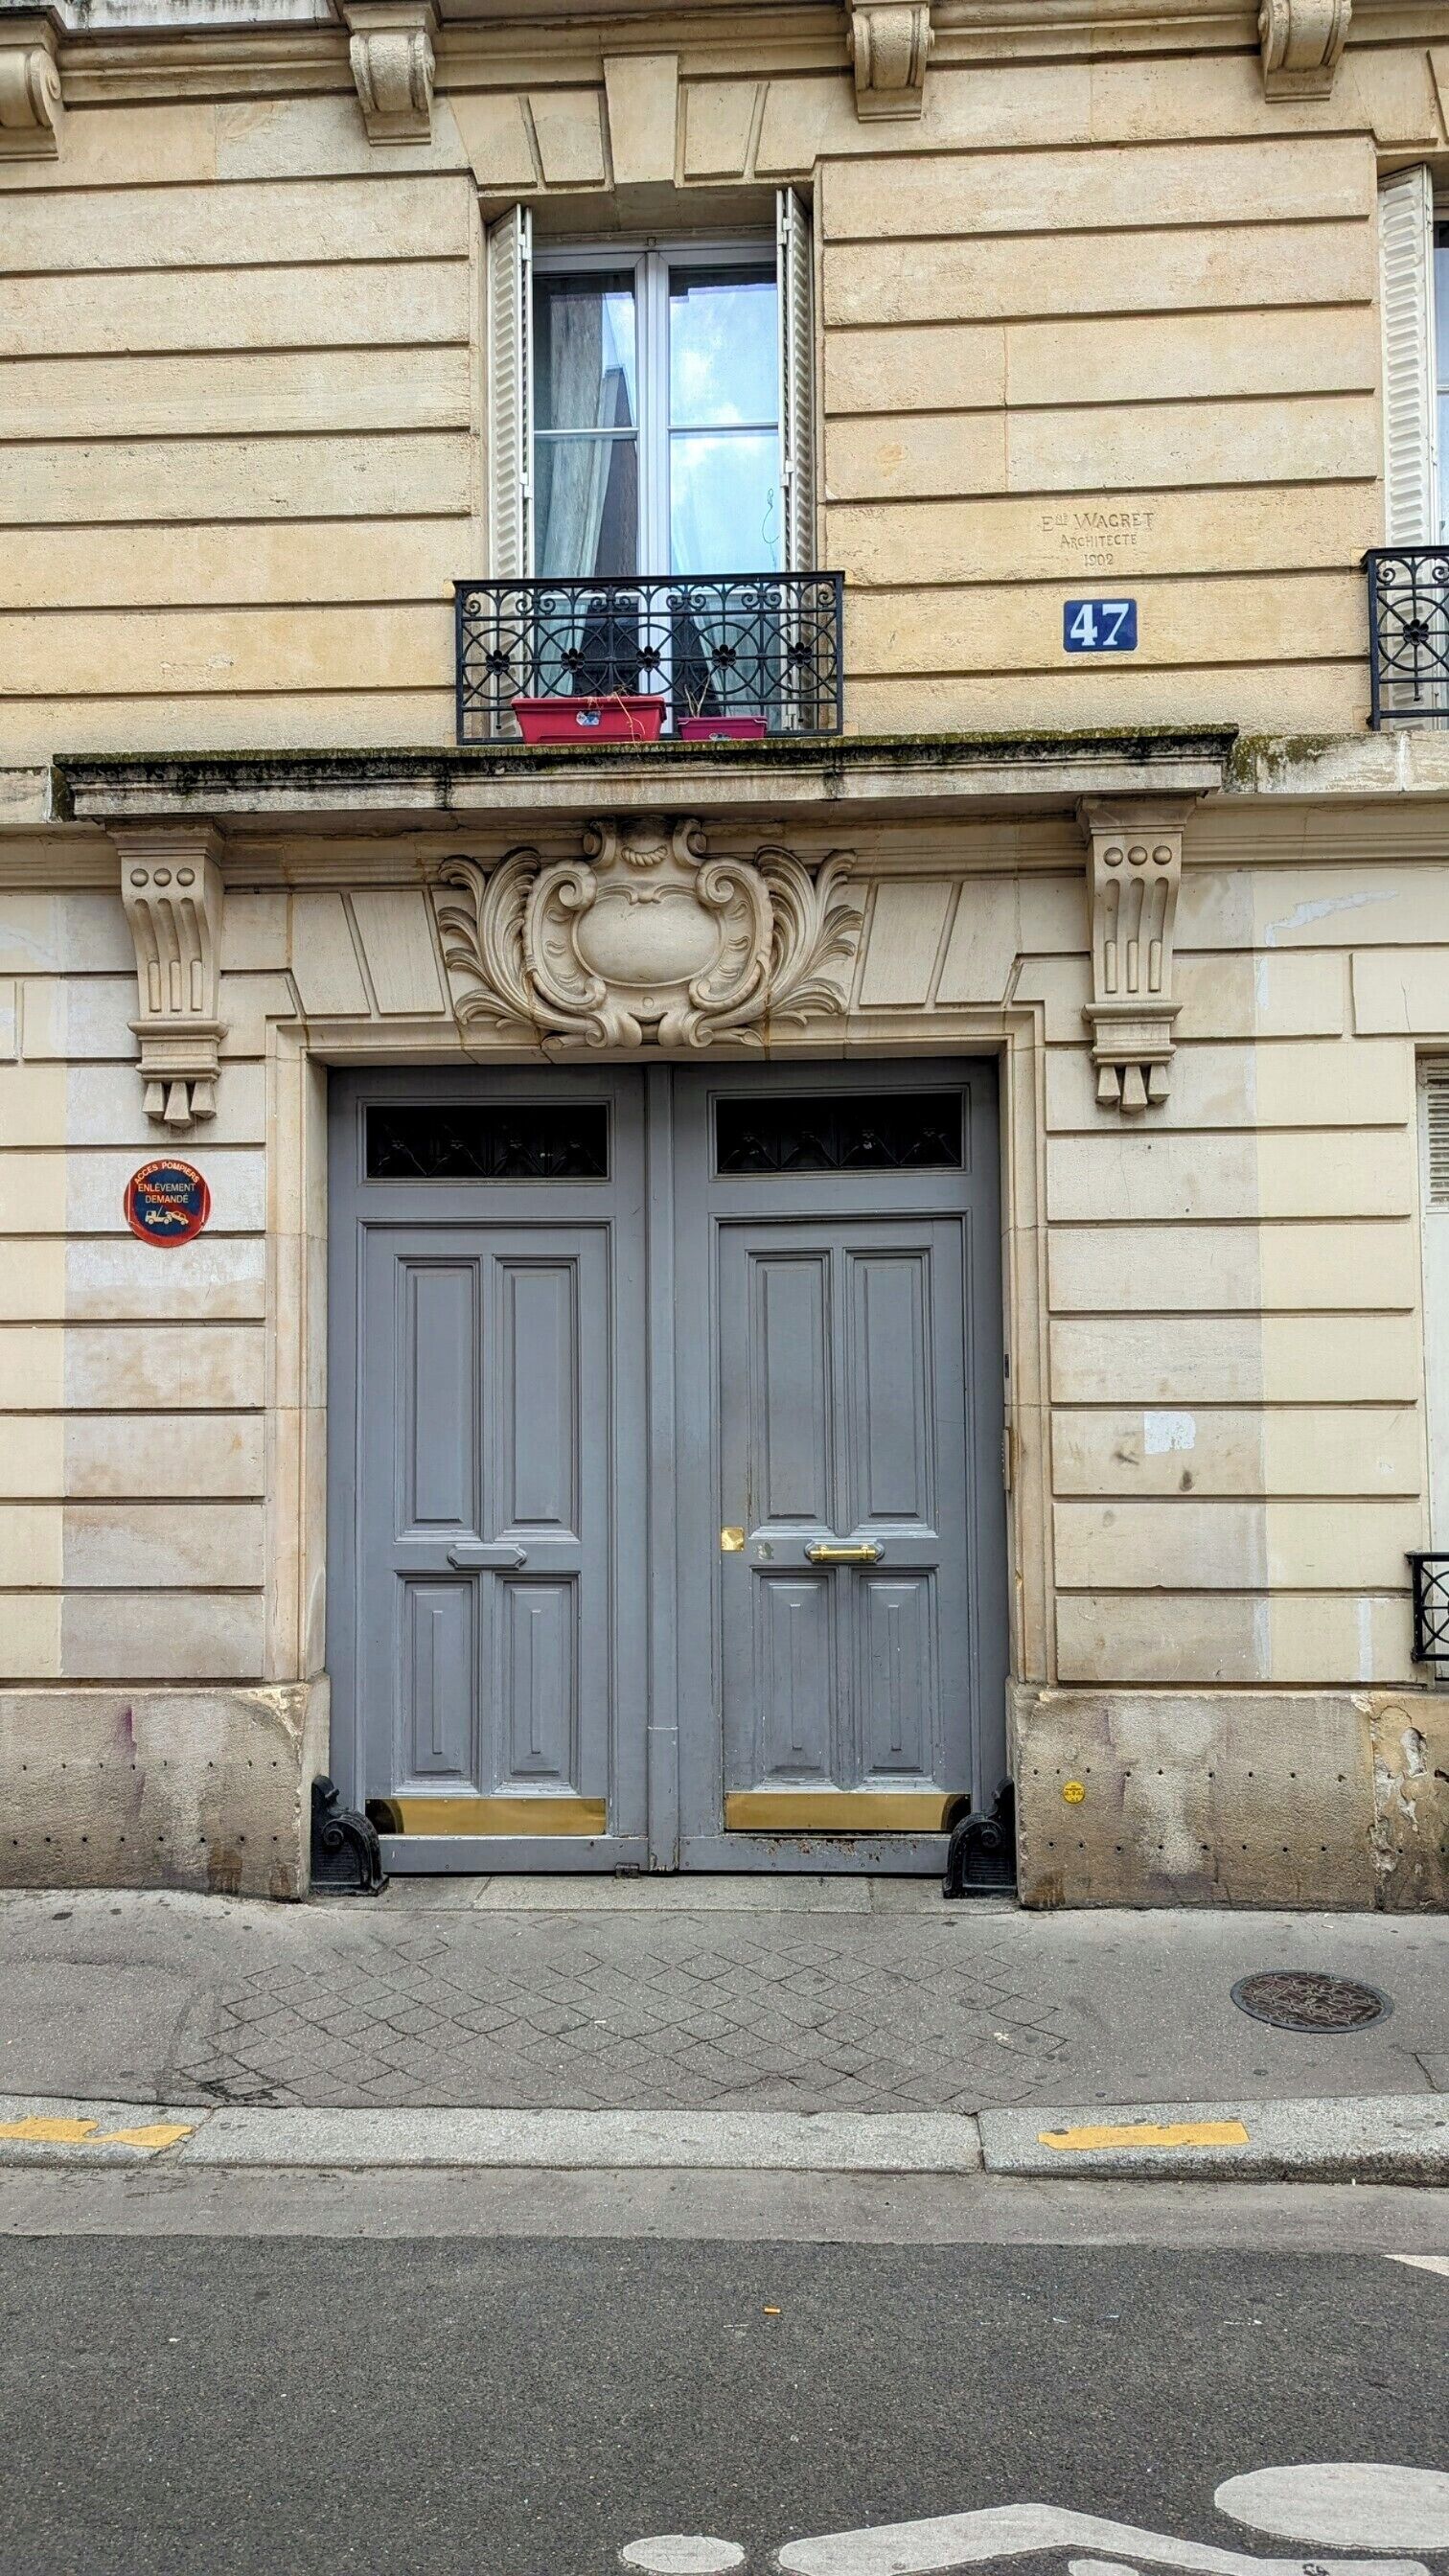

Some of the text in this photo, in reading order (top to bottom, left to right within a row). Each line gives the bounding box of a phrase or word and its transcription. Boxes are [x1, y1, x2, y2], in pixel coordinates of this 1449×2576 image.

[1073, 513, 1154, 529] WAGRET
[1061, 534, 1137, 550] ARCHITECTE
[1084, 553, 1114, 566] 1902
[1070, 603, 1130, 647] 47
[161, 1162, 200, 1183] POMPIERS
[138, 1182, 196, 1192] ENLÈVEMENT
[145, 1193, 189, 1203] DEMANDÉ
